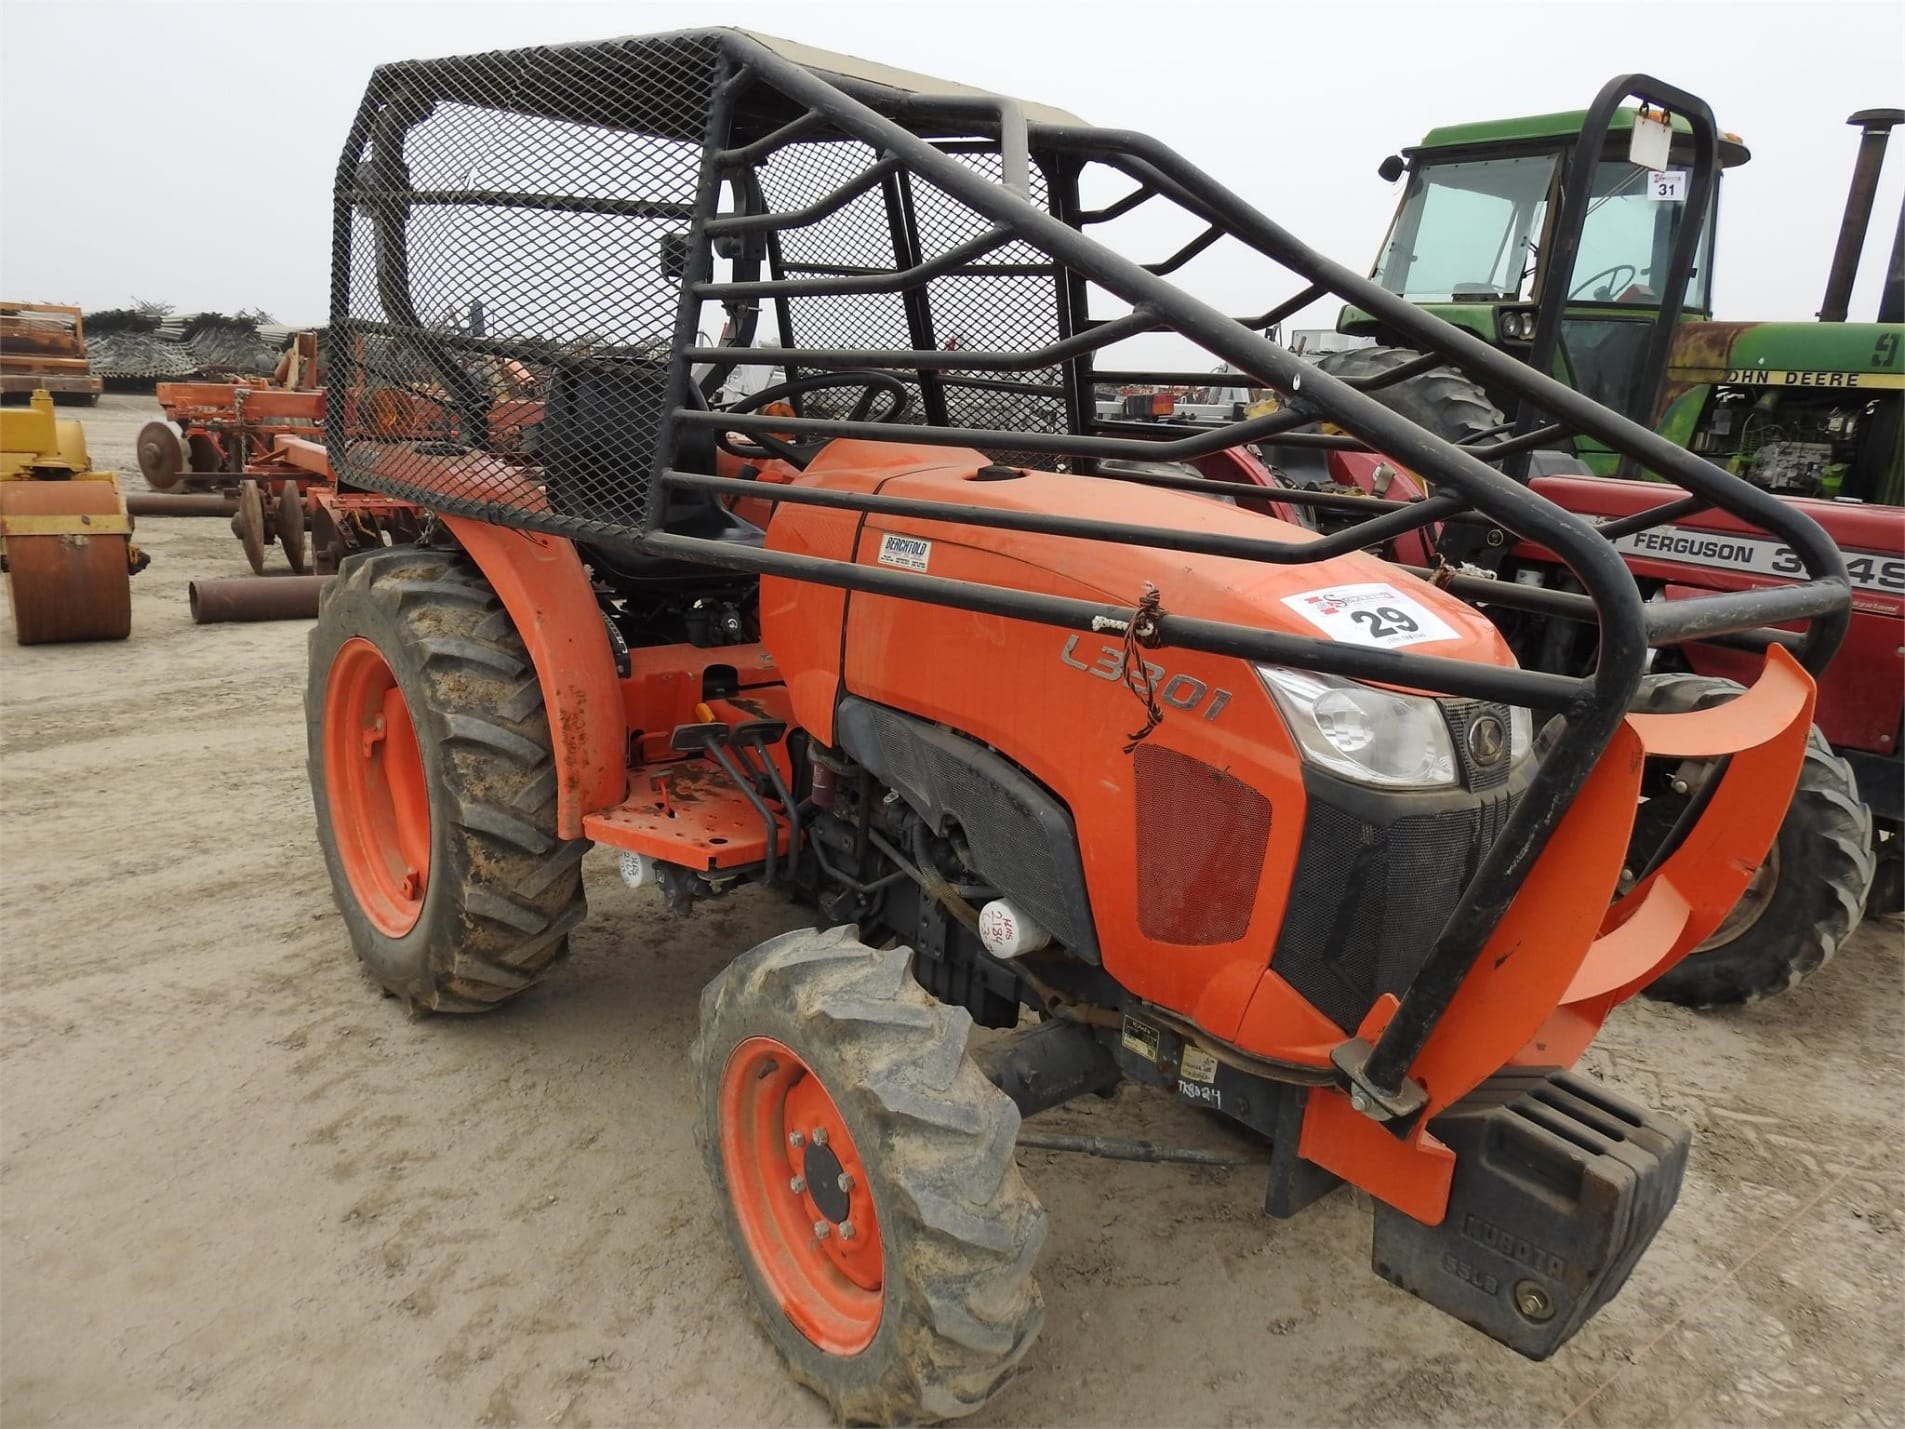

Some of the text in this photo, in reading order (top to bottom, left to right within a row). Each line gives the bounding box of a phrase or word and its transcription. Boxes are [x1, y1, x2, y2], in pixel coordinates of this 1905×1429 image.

[1658, 184, 1675, 196] 31
[1729, 371, 1861, 387] OHN DEERE
[885, 536, 927, 556] BERCHTOLD
[1633, 532, 1905, 589] FERGUSON 34S
[1350, 606, 1419, 639] 29
[1060, 634, 1233, 721] L3301
[1463, 1214, 1567, 1281] KUBOTA
